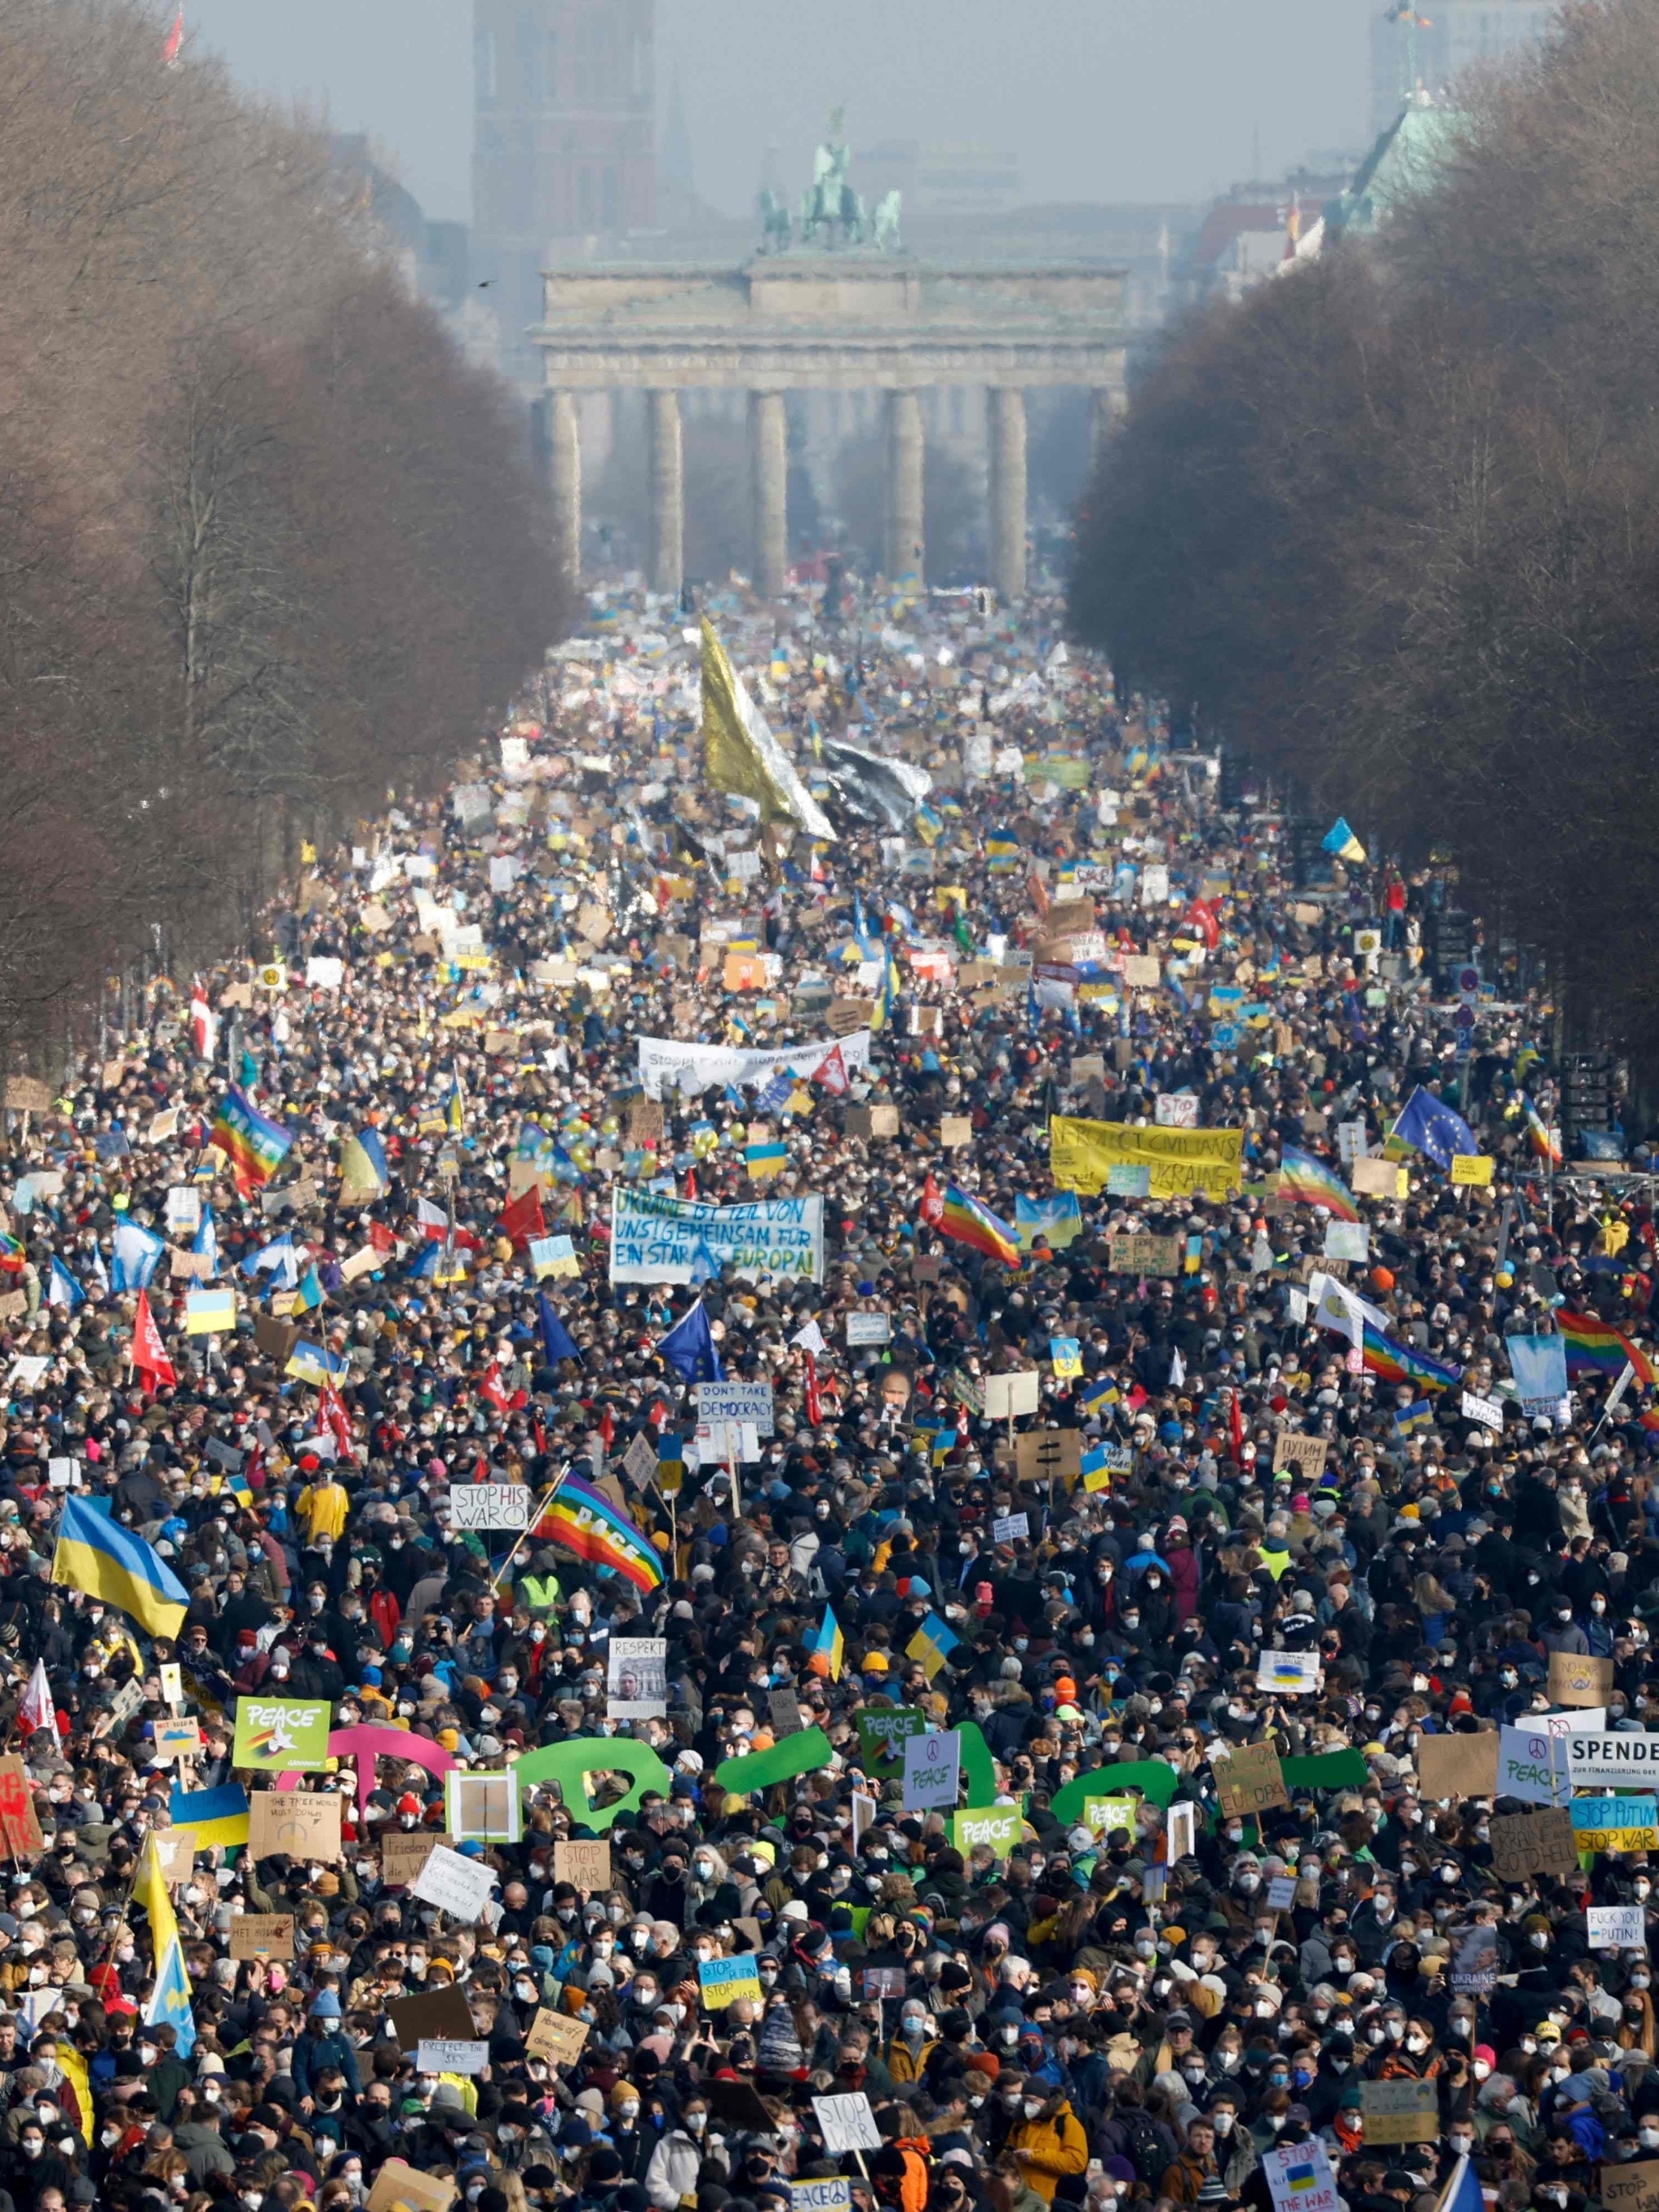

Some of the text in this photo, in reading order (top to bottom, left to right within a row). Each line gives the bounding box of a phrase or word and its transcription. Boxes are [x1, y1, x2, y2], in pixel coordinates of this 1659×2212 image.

[1162, 1098, 1193, 1113] STOP
[1149, 1134, 1236, 1162] CIVILIANS
[1149, 1164, 1228, 1192] UKRAINE
[766, 1198, 806, 1223] VON
[662, 1221, 769, 1246] GEMEINSAM
[778, 1228, 811, 1248] FÜR
[732, 1248, 814, 1275] EUROPA!
[703, 1386, 767, 1399] DONT TAKE
[701, 1402, 773, 1418] DEMOCRACY
[1282, 1440, 1321, 1457] ПУТИН
[457, 1485, 527, 1508] STOP HIS
[456, 1506, 502, 1527] WAR
[574, 1505, 641, 1561] PACE
[615, 1640, 667, 1655] RESPEKT
[246, 1704, 322, 1729] PEACE
[864, 1715, 917, 1736] PEACE
[911, 1764, 951, 1789] PEACE
[1507, 1759, 1565, 1787] PEACE
[1589, 1767, 1640, 1776] FINANZIERUNG
[271, 1797, 285, 1808] THE
[1089, 1805, 1132, 1826] PEACE
[1575, 1802, 1610, 1828] STOP
[961, 1816, 1017, 1845] PEACE
[1580, 1828, 1654, 1851] STOP WAR
[388, 1839, 428, 1858] Frieden
[564, 1846, 603, 1864] STOP
[1541, 1843, 1576, 1865] HELL
[389, 1866, 403, 1877] die
[569, 1867, 601, 1887] WAR
[1590, 1912, 1617, 1925] FUCK
[1601, 1928, 1639, 1941] PUTIN!
[703, 1961, 757, 1980] STOP PUTIN
[1450, 1973, 1497, 1985] UKRAINE
[706, 1982, 734, 1999] STOP
[423, 2041, 484, 2053] PROTECT THE
[817, 2093, 868, 2124] STOP
[826, 2123, 875, 2150] WAR
[1277, 2143, 1320, 2173] STOP
[790, 2183, 828, 2209] EACE
[1279, 2189, 1334, 2212] THE WAR
[1606, 2180, 1648, 2200] STOP
